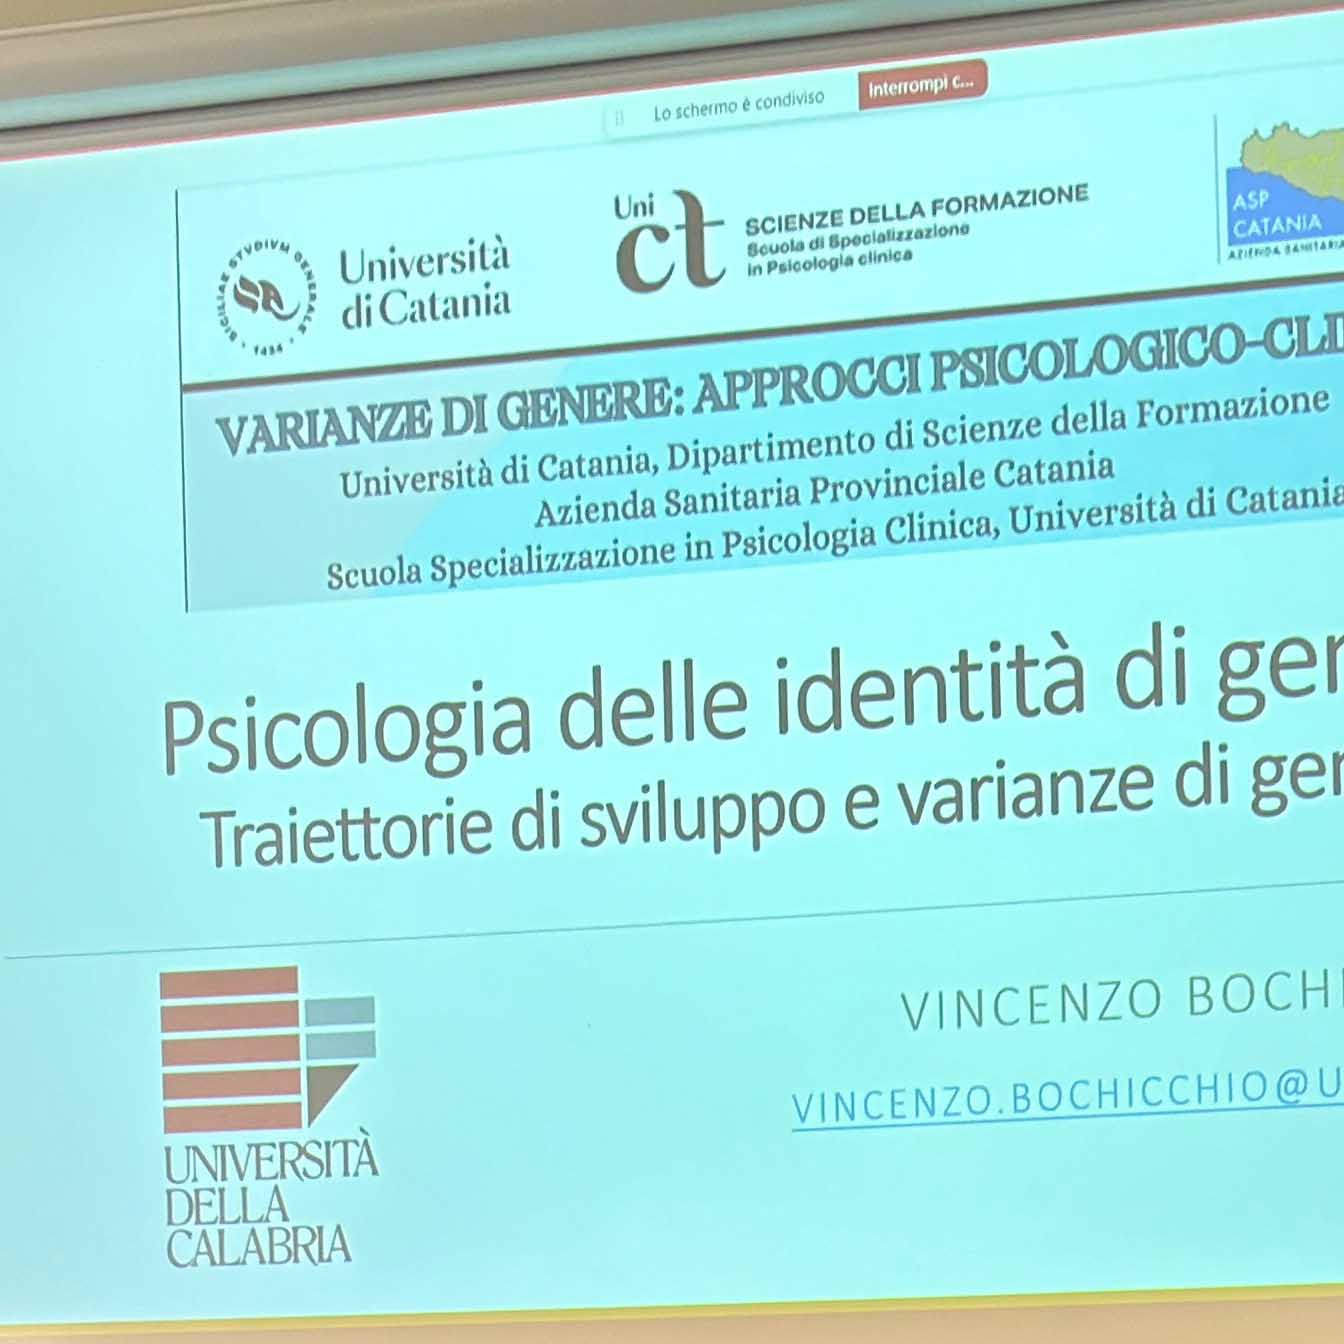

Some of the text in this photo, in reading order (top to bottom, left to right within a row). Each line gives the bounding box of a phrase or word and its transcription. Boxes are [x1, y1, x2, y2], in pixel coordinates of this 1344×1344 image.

[654, 89, 825, 121] Lo schermo è condiviso
[868, 75, 950, 98] Interrompi
[613, 192, 655, 220] Uni
[745, 183, 1089, 237] SCIENZE DELLA FORMAZIONE
[1232, 189, 1269, 212] ASP
[616, 188, 727, 294] ct
[747, 222, 970, 257] Scuola di Specializzazione
[1233, 214, 1323, 239] CATANIA
[339, 234, 511, 285] Università
[747, 247, 913, 277] in Psicologia clinica
[1228, 244, 1281, 261] AZIENDA
[342, 283, 512, 330] di Catania
[215, 399, 432, 457] VARIANZE
[442, 393, 488, 436] DI
[497, 375, 686, 432] GENERE:
[692, 352, 921, 414] APPROCCI
[340, 386, 1331, 499] Università di Catania, Dipartimento di Scienze della Formazione
[534, 449, 1116, 529] Azienda Sanitaria Provinciale Catania
[327, 555, 423, 592] Scuola
[429, 540, 676, 588] Specializzazione
[683, 531, 713, 560] in
[721, 517, 877, 559] Psicologia
[885, 509, 1001, 546] Clinica,
[1009, 489, 1177, 535] Università
[1185, 486, 1217, 518] di
[164, 679, 532, 779] Psicologia
[559, 657, 749, 751] delle
[776, 630, 1085, 736] identità
[1116, 619, 1187, 710] di
[199, 796, 493, 869] Traiettorie
[511, 787, 560, 851] di
[580, 779, 826, 855] sviluppo
[845, 780, 881, 830] e
[898, 758, 1156, 827] varianze
[1174, 740, 1229, 806] di
[900, 976, 1163, 1032] VINCENZO
[163, 1125, 380, 1185] UNIVERSITÀ
[165, 1183, 290, 1227] DELLA
[166, 1223, 352, 1269] CALABRIA
